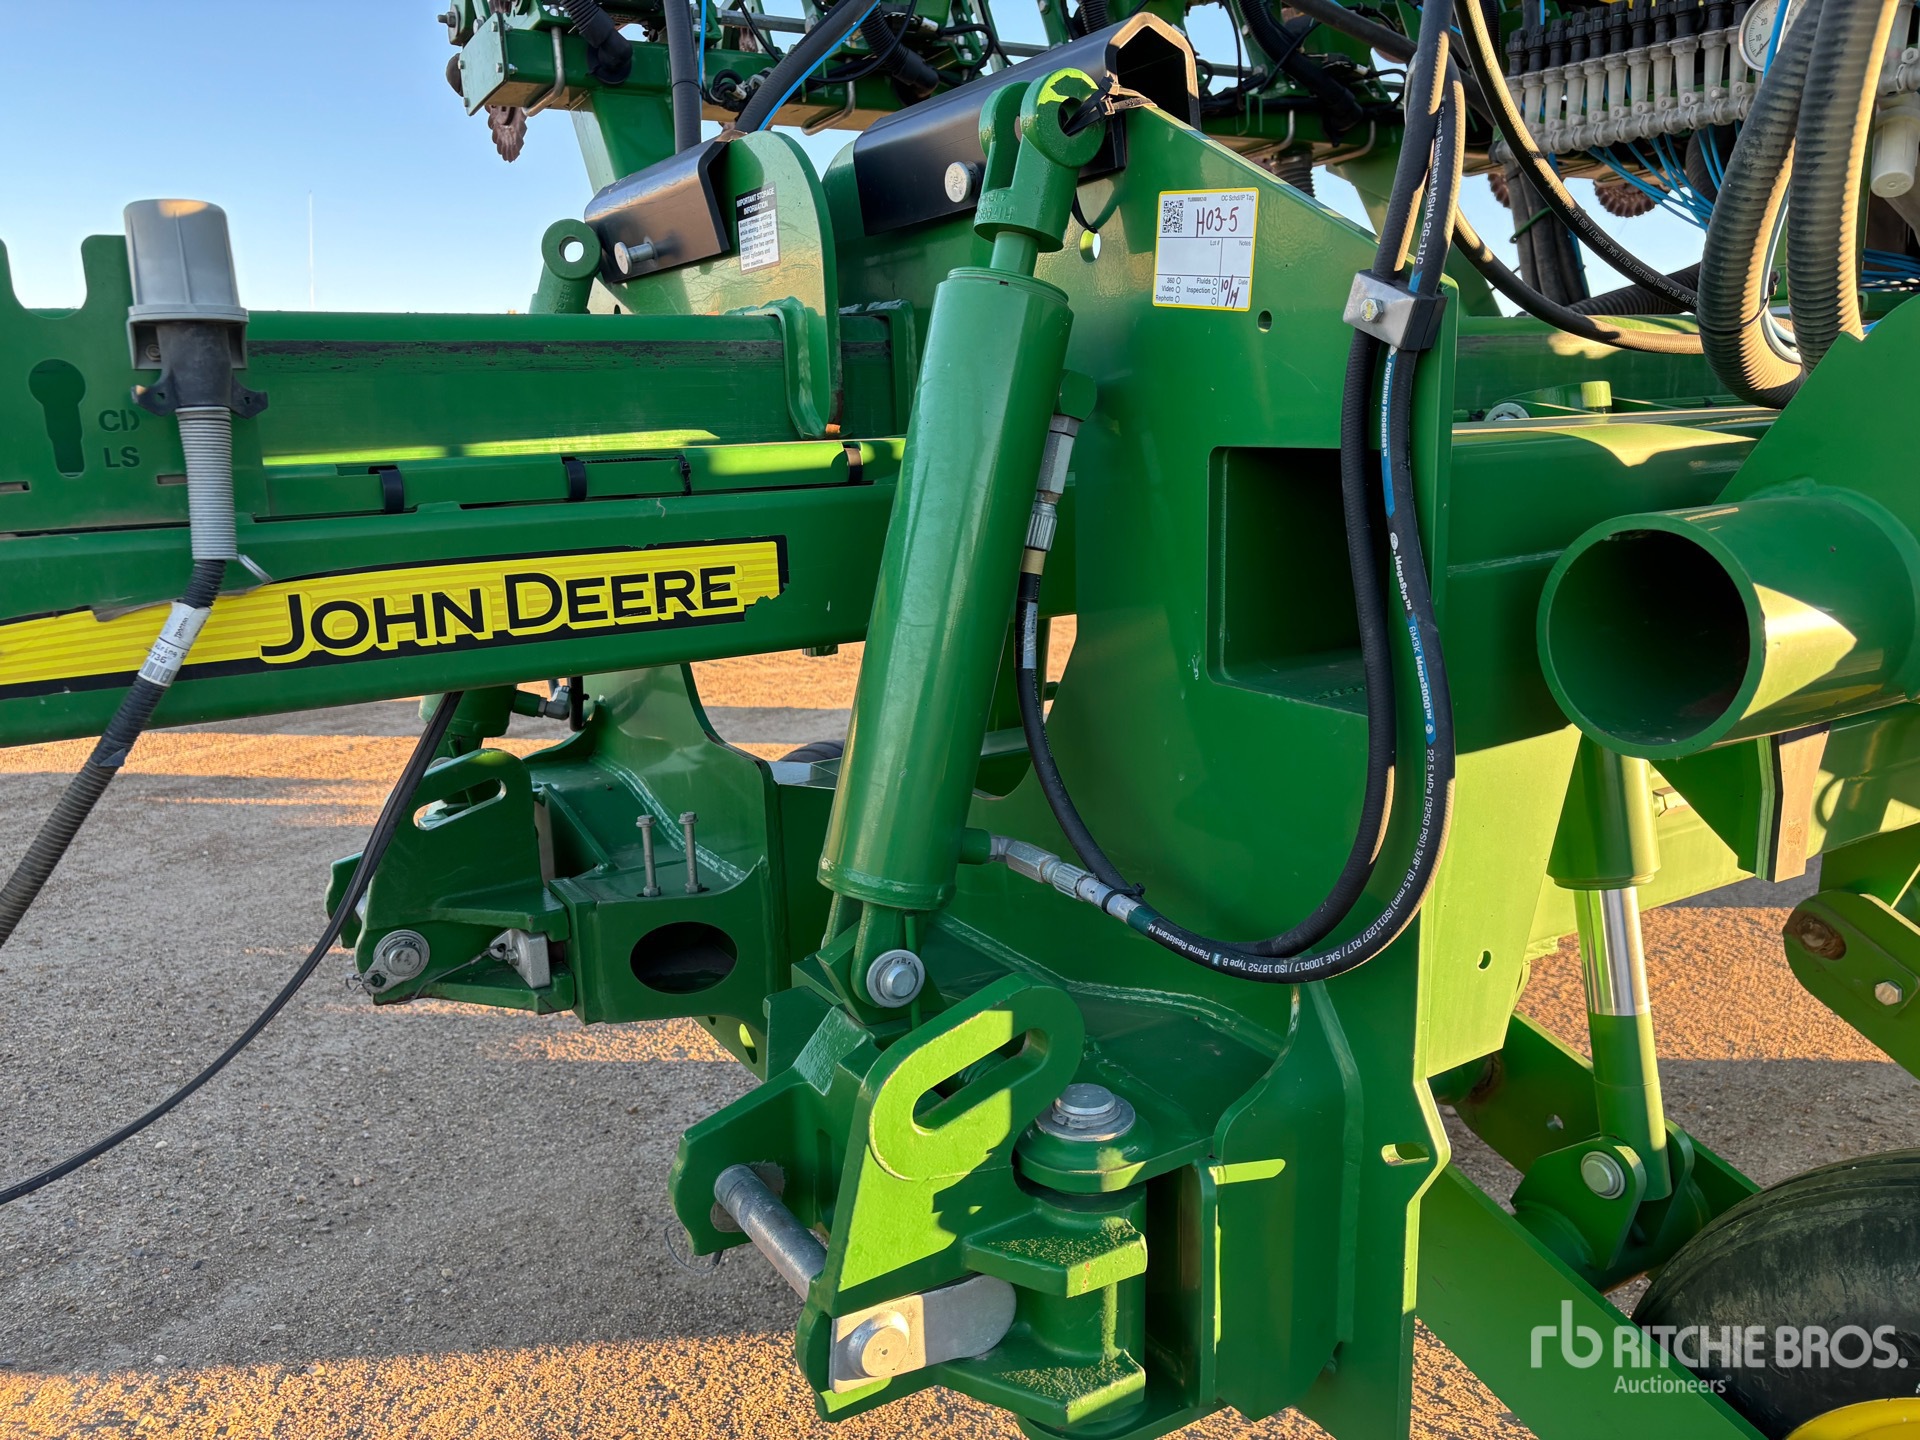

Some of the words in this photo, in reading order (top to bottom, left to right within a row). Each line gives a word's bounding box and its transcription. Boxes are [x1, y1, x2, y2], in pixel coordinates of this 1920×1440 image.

[1761, 18, 1768, 26] 20
[1431, 136, 1443, 187] Resistant
[757, 187, 775, 200] STORAGE
[1427, 188, 1438, 221] MSHA
[1416, 222, 1432, 264] 2G-11C
[1382, 362, 1392, 405] POWERING
[103, 446, 140, 468] LS
[260, 588, 484, 657] JOHN
[504, 566, 739, 630] DEERE
[1409, 626, 1421, 654] 6M3K
[1422, 796, 1433, 826] (3250
[1419, 827, 1429, 848] PSI)
[1403, 869, 1417, 889] (9.5
[1391, 888, 1406, 910] mm)
[1363, 908, 1395, 944] ISO11237
[1156, 927, 1188, 950] Resistant
[1347, 938, 1362, 954] R17
[1188, 944, 1211, 960] Flame
[1222, 957, 1228, 966] B
[1326, 951, 1341, 964] SAE
[1230, 959, 1247, 971] Type
[1248, 962, 1273, 974] 18752
[1274, 963, 1289, 974] ISO
[1294, 958, 1325, 973] 100R17
